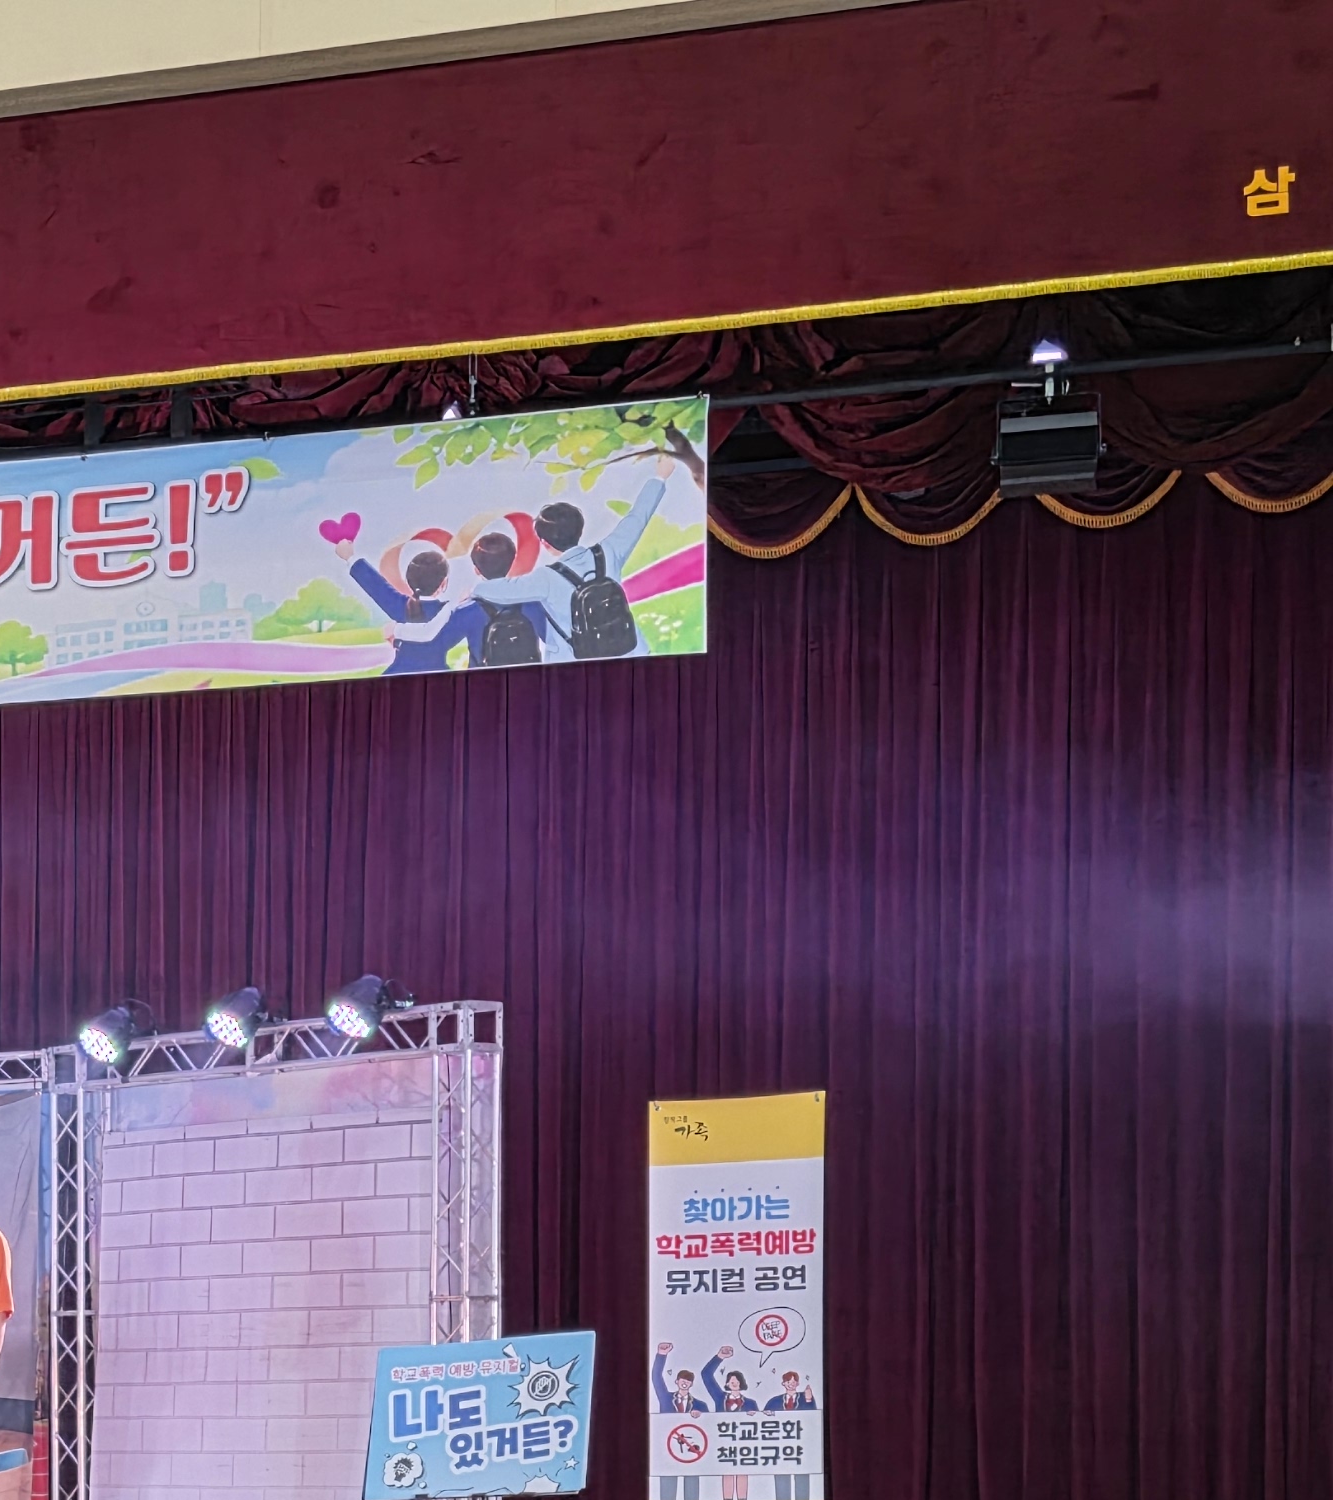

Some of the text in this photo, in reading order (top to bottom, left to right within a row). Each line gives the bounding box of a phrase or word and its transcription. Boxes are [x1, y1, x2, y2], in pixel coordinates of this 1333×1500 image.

[1244, 166, 1295, 216] 삼
[674, 1121, 709, 1141] 가족
[683, 1195, 790, 1224] 찾아가는
[655, 1228, 817, 1259] 학교폭력예방
[665, 1264, 807, 1295] 뮤지컬 공연
[393, 1359, 520, 1381] 학교폭력 예방 뮤지컬
[392, 1389, 483, 1438] 나도
[449, 1418, 574, 1470] 있거든?
[717, 1420, 804, 1441] 학교문화
[717, 1445, 804, 1466] 책임규약
